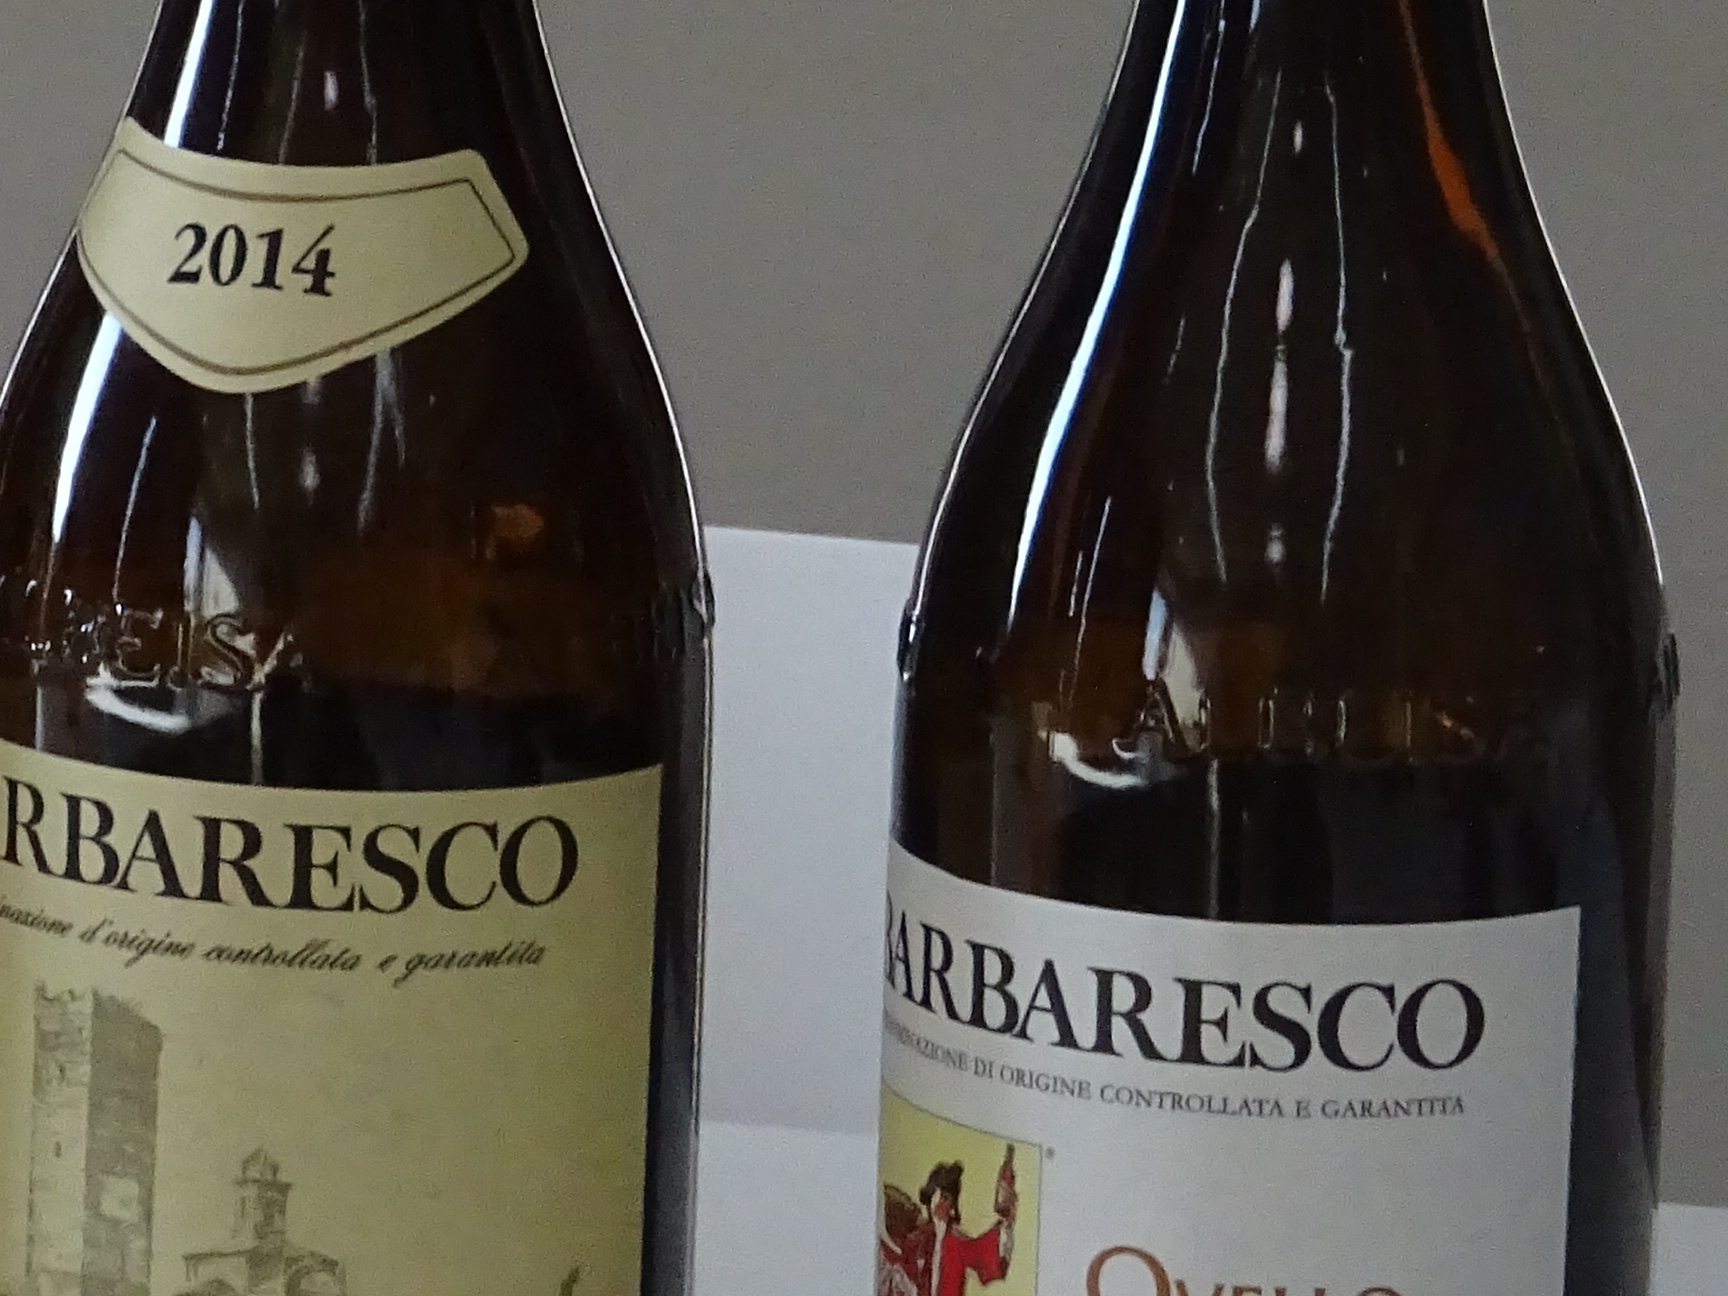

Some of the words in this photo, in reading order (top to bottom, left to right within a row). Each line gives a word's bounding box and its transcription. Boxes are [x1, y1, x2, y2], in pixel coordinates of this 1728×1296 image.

[165, 221, 337, 298] 2014
[77, 916, 197, 970] d'origine
[200, 937, 363, 973] controllata
[391, 935, 547, 989] garantita
[972, 1055, 995, 1080] DI
[999, 1064, 1093, 1102] ORIGINE
[1099, 1084, 1285, 1119] CONTROLLATA
[1321, 1094, 1466, 1120] GARANTITA
